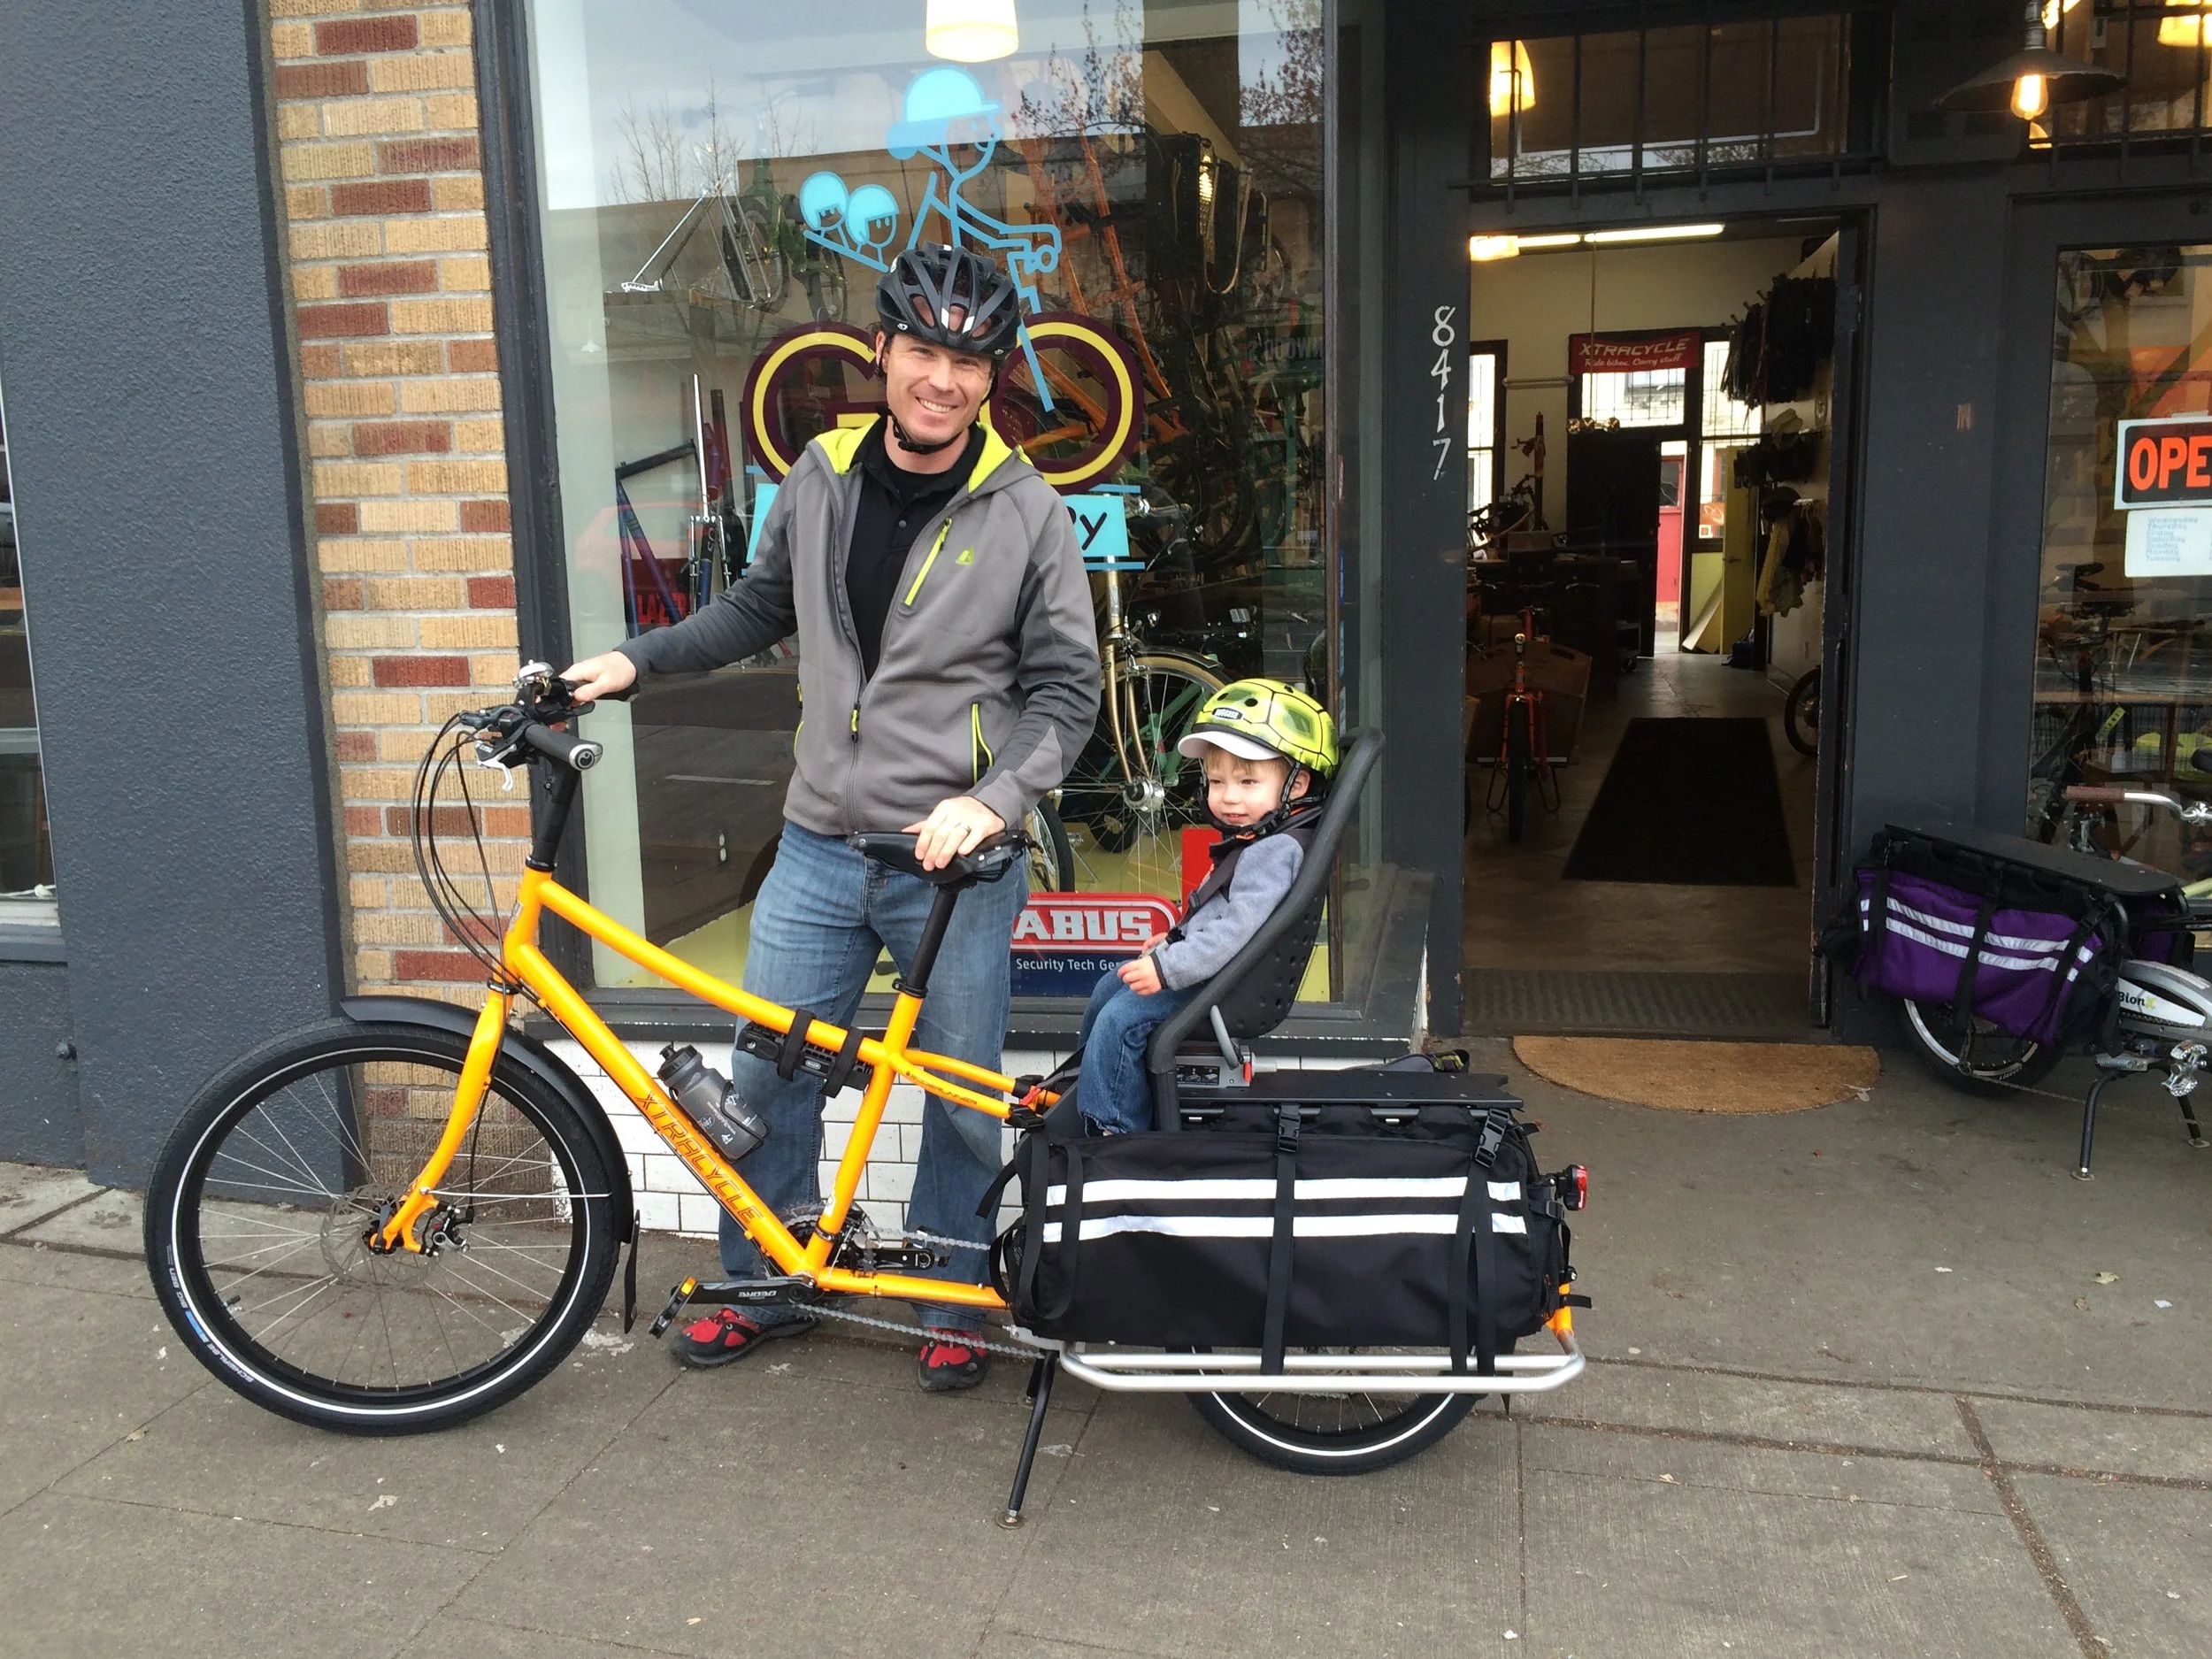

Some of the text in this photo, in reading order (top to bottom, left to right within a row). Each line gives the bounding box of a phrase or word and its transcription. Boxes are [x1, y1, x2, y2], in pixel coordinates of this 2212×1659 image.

[1579, 338, 1691, 356] XTRACYCLE
[1632, 357, 1657, 367] Carry
[1431, 305, 1455, 480] 8417
[1012, 910, 1153, 941] ABUS
[1016, 958, 1064, 972] Security
[1067, 959, 1094, 971] Tech
[634, 1090, 764, 1224] XTRACYCLE
